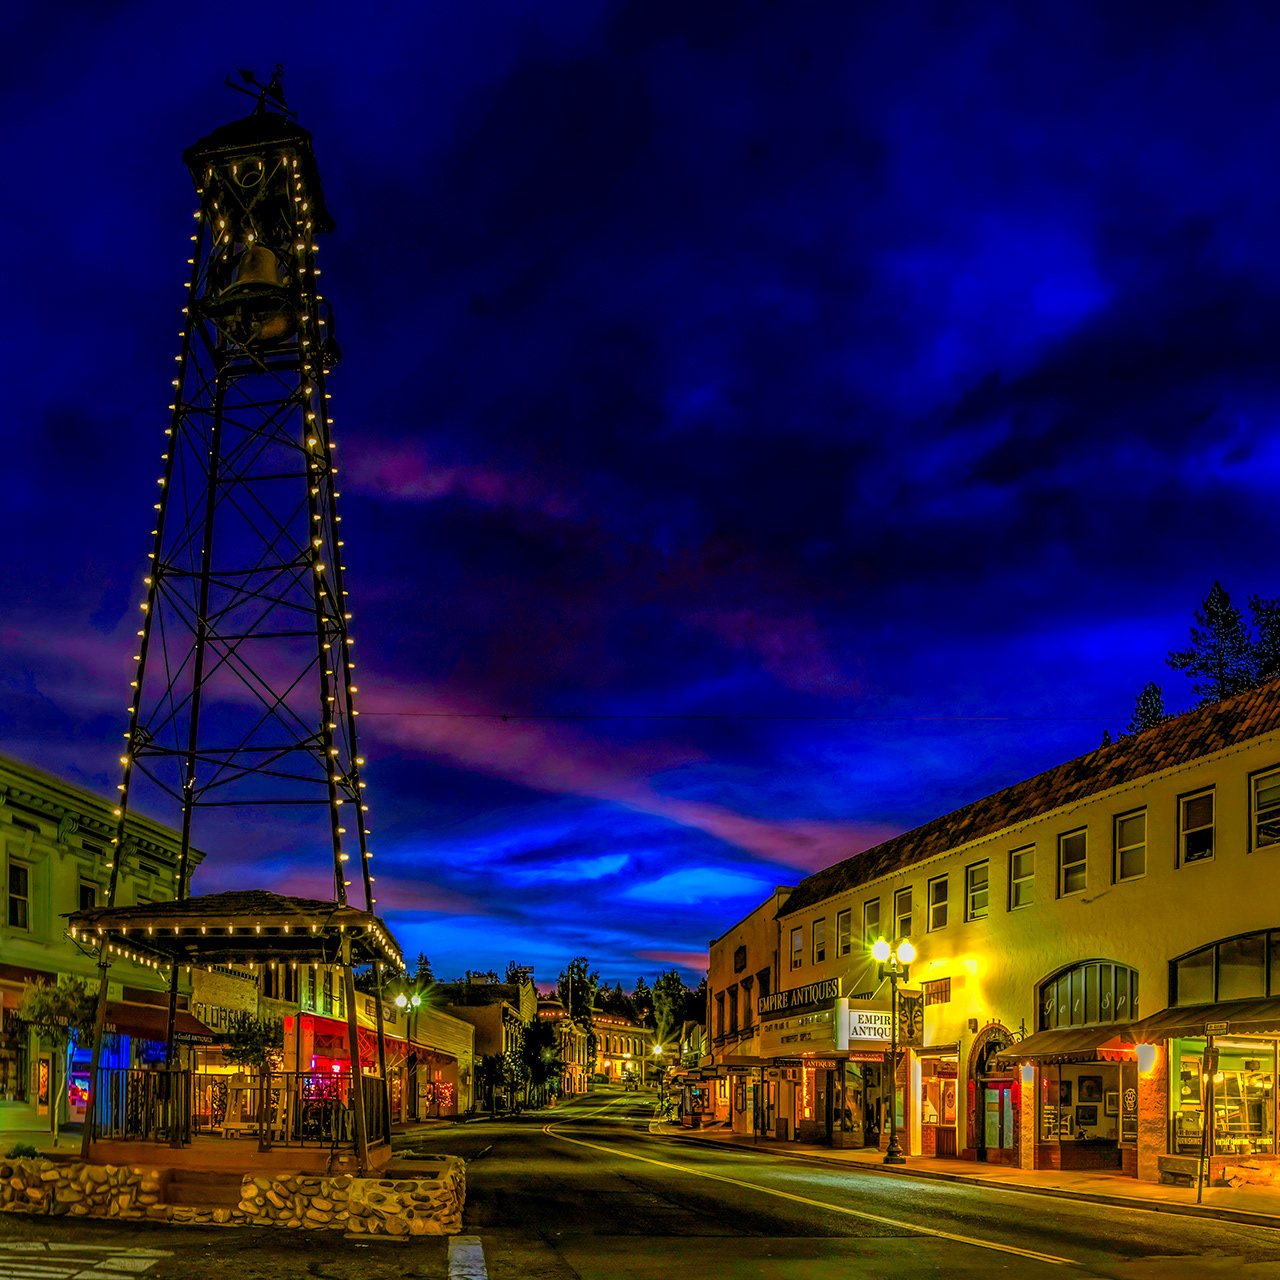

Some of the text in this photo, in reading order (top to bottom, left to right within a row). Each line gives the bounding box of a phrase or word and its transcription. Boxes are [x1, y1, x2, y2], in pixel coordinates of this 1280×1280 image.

[759, 980, 838, 1013] EMPIRE ANTIQUES
[806, 1060, 836, 1068] ANTIQUES
